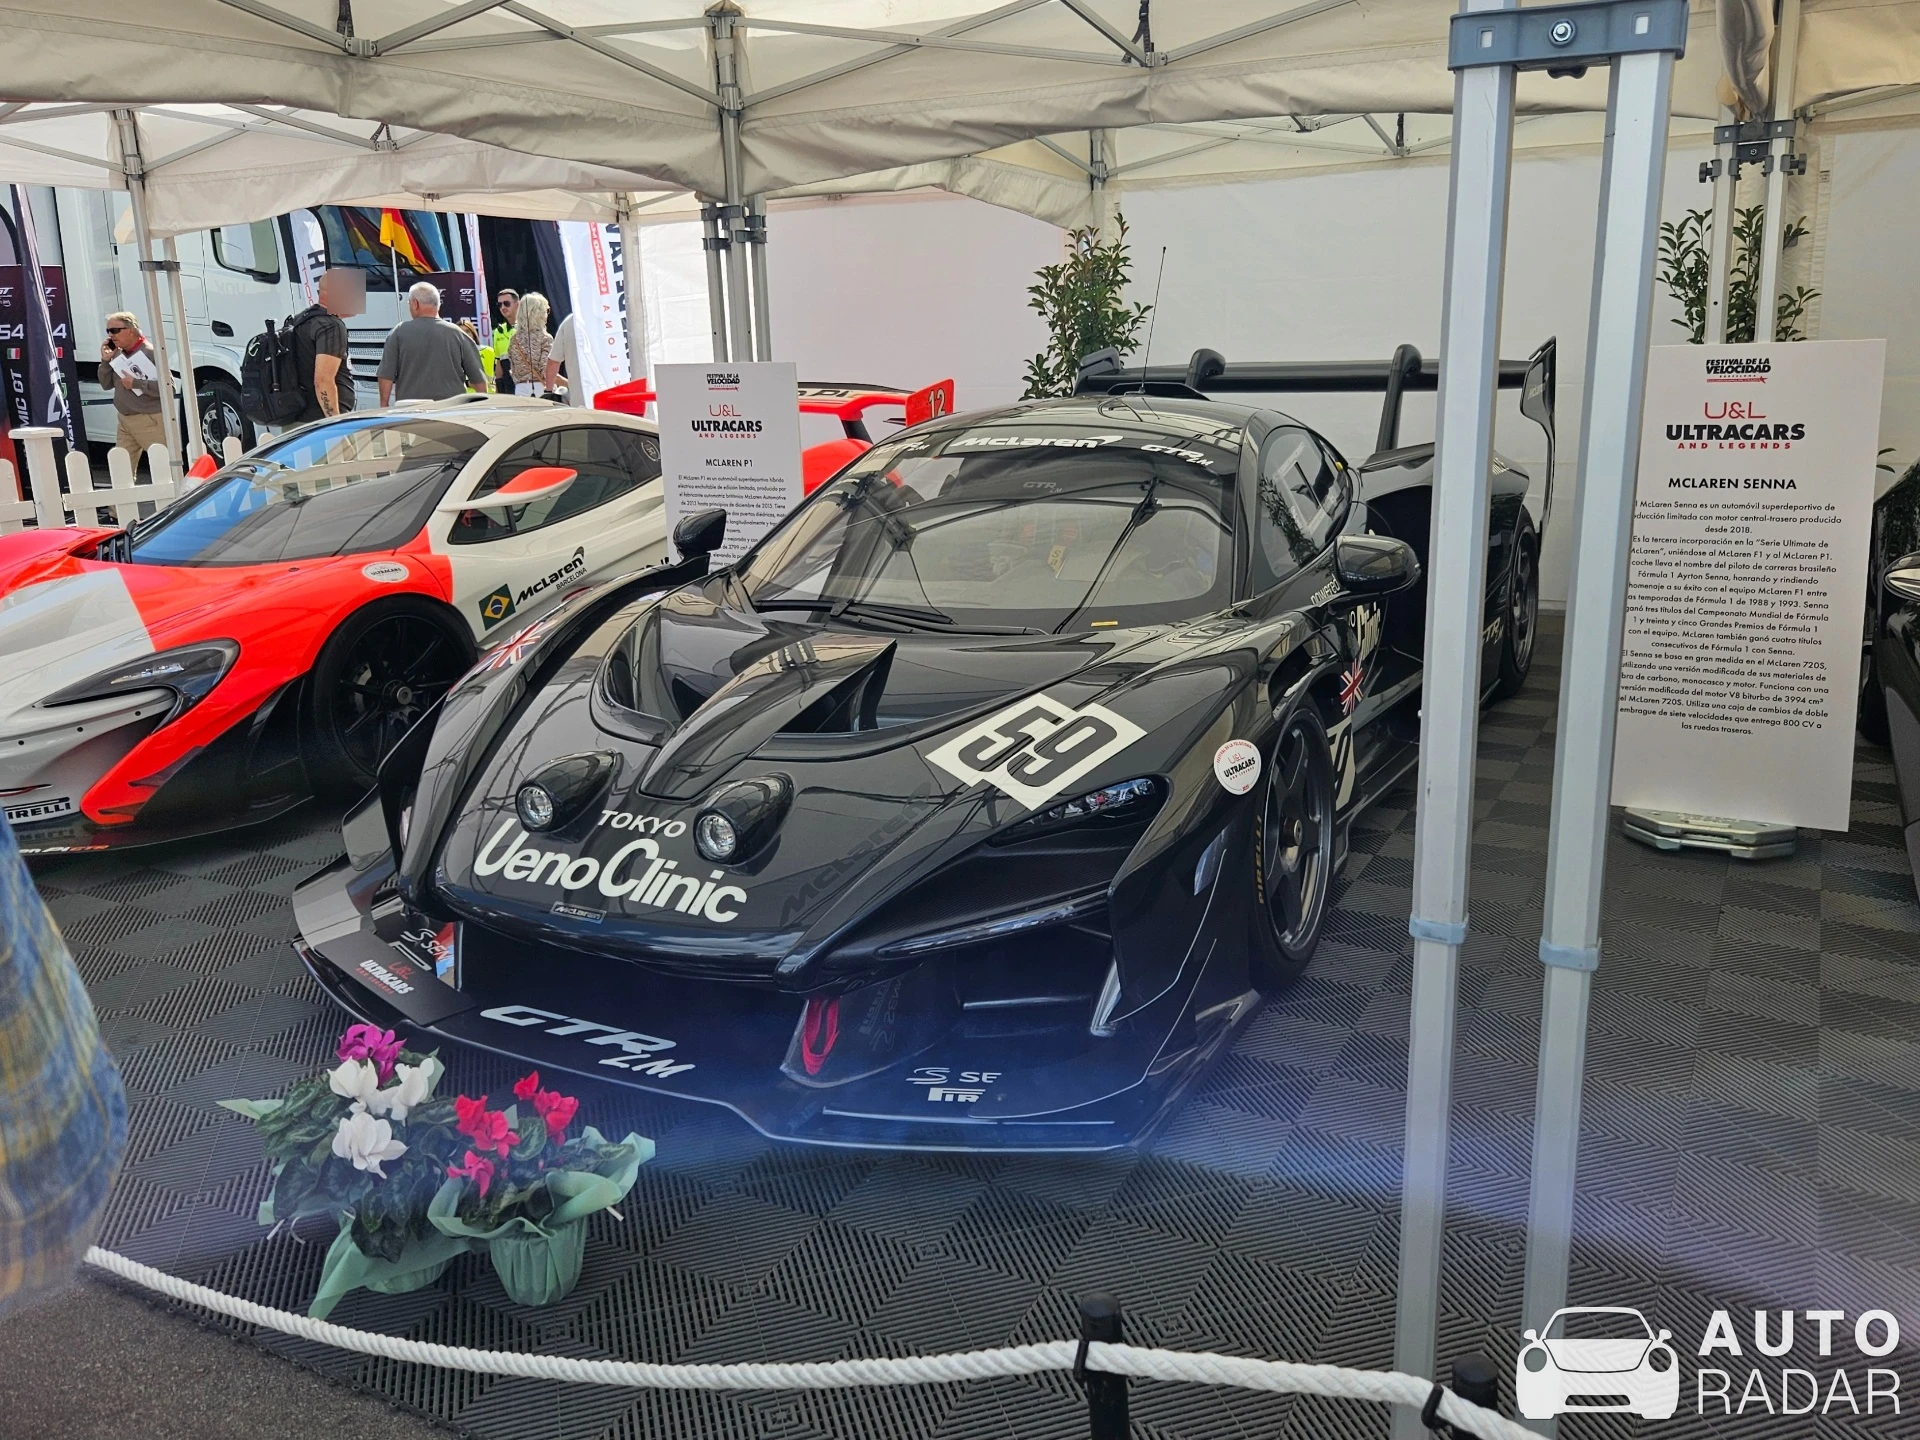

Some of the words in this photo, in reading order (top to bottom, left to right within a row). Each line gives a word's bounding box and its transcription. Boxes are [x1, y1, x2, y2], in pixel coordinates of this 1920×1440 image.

[1706, 364, 1771, 374] VELOCIDAD
[11, 368, 24, 393] GT
[709, 404, 742, 417] U&L
[928, 388, 946, 419] 12
[1704, 402, 1767, 419] U&L
[691, 420, 763, 432] ULTRACARS
[1666, 423, 1806, 441] ULTRACARS
[950, 435, 1099, 449] McLaren
[1677, 442, 1708, 450] AND
[1719, 442, 1792, 450] LEGENDS
[1140, 444, 1204, 459] GTR
[705, 458, 742, 467] MCLAREN
[743, 459, 753, 467] P1
[1186, 458, 1214, 466] LM
[1668, 477, 1739, 489] MCLAREN
[1743, 478, 1797, 490] SENNA
[1673, 500, 1697, 508] Senna
[1761, 502, 1822, 511] superdeportivo
[1666, 512, 1697, 520] limitada
[1739, 514, 1797, 522] central-trasero
[1799, 515, 1841, 524] producido
[1729, 525, 1752, 533] 2018.
[1679, 536, 1732, 545] incorporación
[1782, 539, 1816, 547] Ultimate
[1654, 558, 1672, 566] lleva
[1683, 560, 1712, 568] nombre
[1727, 561, 1750, 570] piloto
[1752, 562, 1762, 570] de
[1798, 564, 1836, 572] brasileño
[514, 556, 584, 606] McLaren
[555, 567, 588, 591] BARCELONA
[1637, 570, 1668, 578] Fórmula
[1676, 572, 1703, 580] Ayrton
[1704, 572, 1731, 581] Senna,
[1732, 573, 1771, 582] honrando
[1779, 576, 1818, 584] rindiendo
[1310, 573, 1340, 605] powered
[1647, 686, 1689, 694] modificada
[1742, 691, 1770, 701] biturbo
[1771, 694, 1782, 702] de
[1784, 695, 1806, 703] 3994
[1619, 706, 1656, 715] embrague
[1687, 711, 1732, 721] velocidades
[1750, 718, 1781, 726] entrega
[1782, 718, 1800, 726] 800
[958, 705, 1118, 788] 59
[1223, 756, 1256, 778] ULTRACARS
[597, 809, 687, 838] TOKYO
[780, 800, 930, 927] McLaren
[1255, 814, 1265, 905] PIRELLI
[473, 817, 600, 890] Ueno
[599, 837, 748, 923] Clinic
[554, 905, 601, 920] McLaren
[359, 959, 415, 994] ULTRACARS
[480, 1005, 677, 1054] GTR
[598, 1053, 696, 1079] LM
